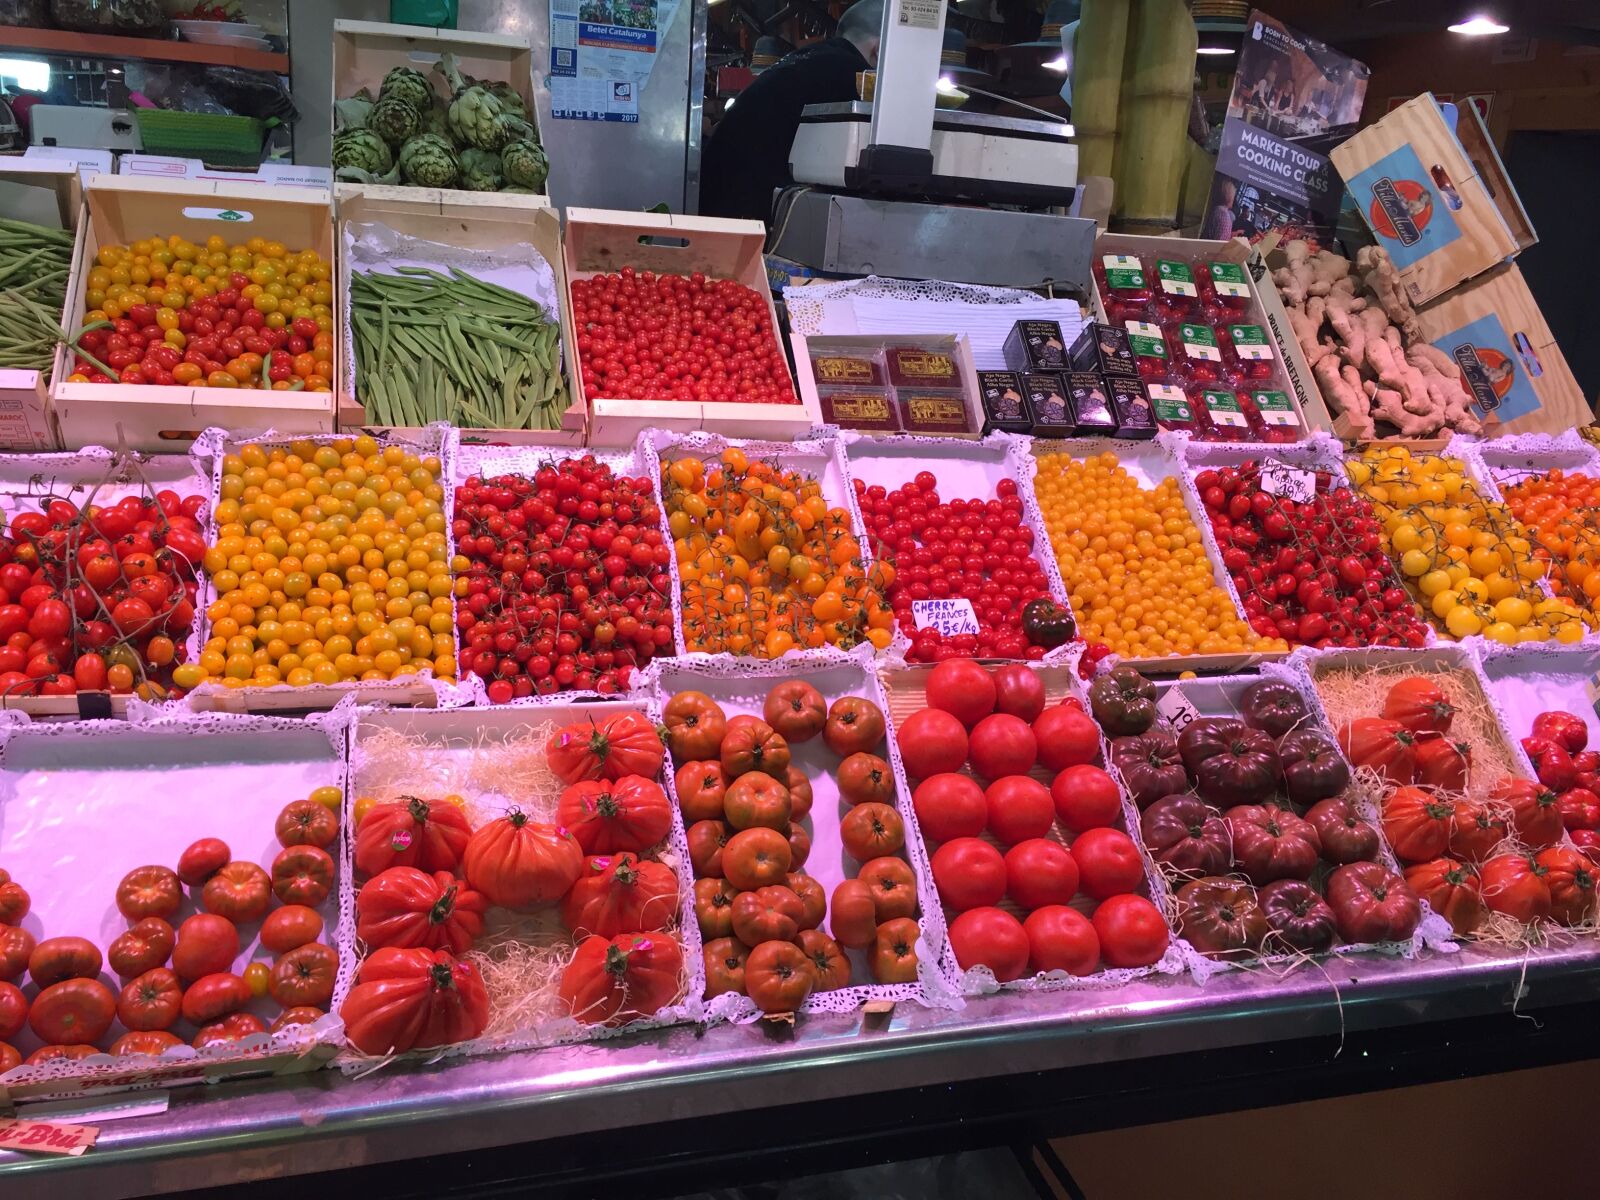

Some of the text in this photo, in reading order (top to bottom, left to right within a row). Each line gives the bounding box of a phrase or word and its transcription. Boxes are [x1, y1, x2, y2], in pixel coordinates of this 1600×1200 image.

[587, 25, 608, 35] Betel
[608, 28, 647, 39] Catalunya
[1265, 27, 1281, 39] BORN
[1281, 34, 1290, 43] TO
[1289, 39, 1307, 52] COOK
[621, 114, 638, 122] 2017
[1241, 129, 1289, 159] MARKET
[1290, 149, 1320, 171] TOUR
[1237, 145, 1292, 177] COOKING
[1293, 169, 1329, 193] CLASS
[1268, 313, 1309, 409] PRINCE de BRETAGNE
[913, 600, 956, 614] CHERRY
